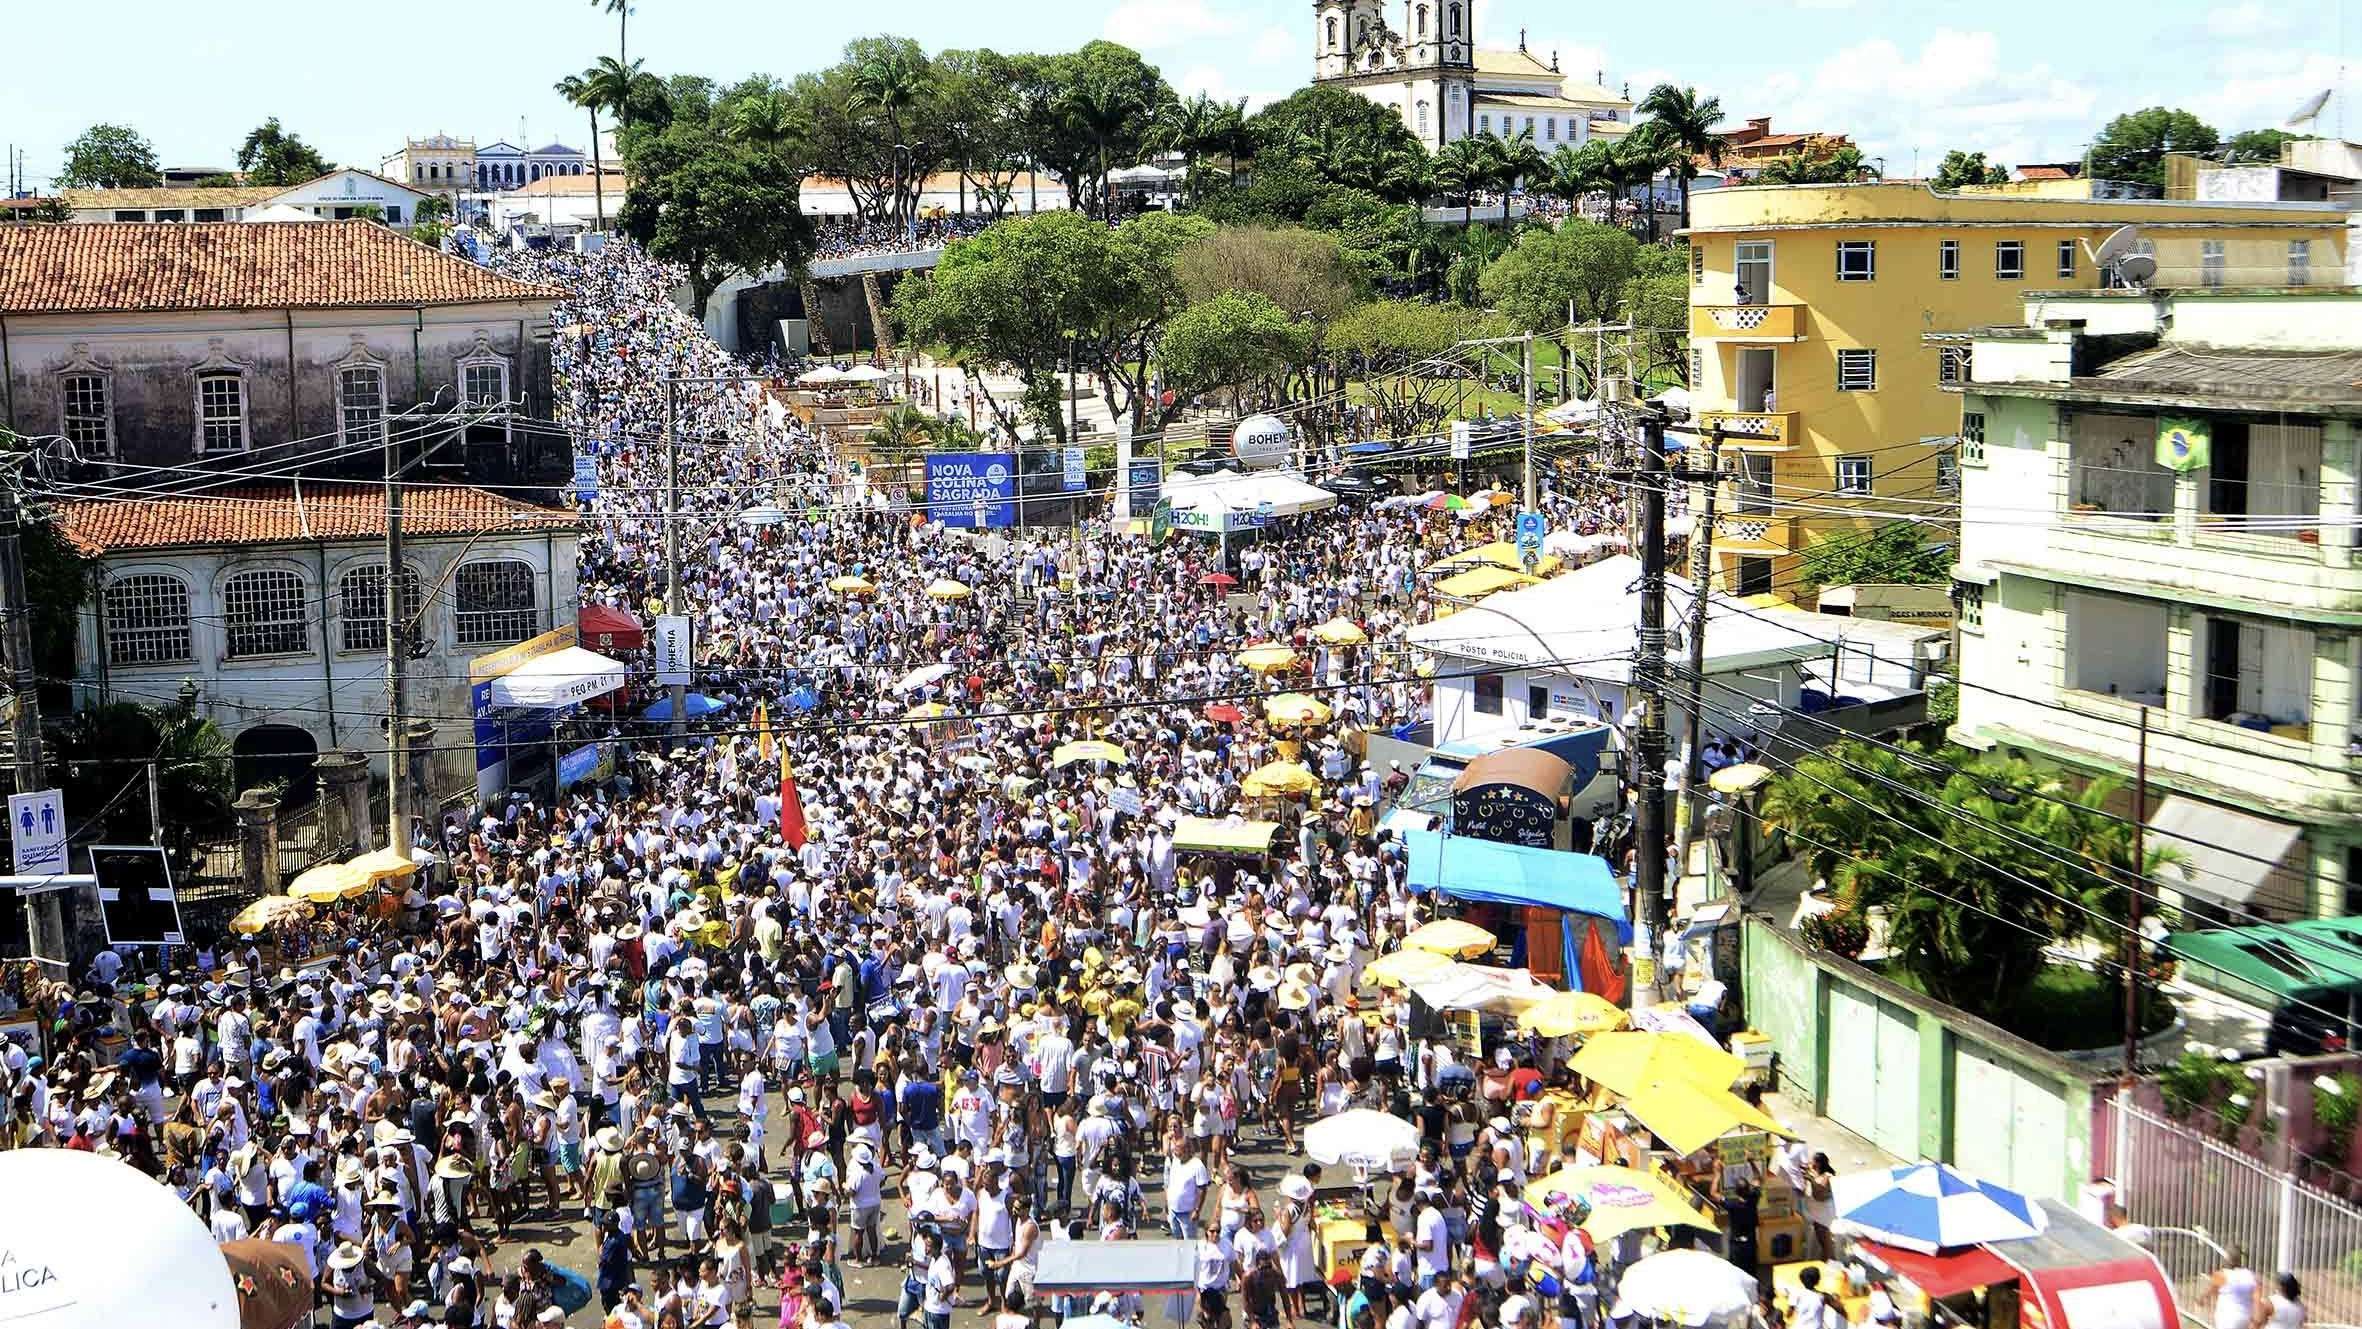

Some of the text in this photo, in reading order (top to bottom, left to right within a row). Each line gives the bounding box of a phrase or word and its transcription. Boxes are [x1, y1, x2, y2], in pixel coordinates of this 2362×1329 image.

[932, 464, 973, 476] NOVA
[932, 476, 987, 488] COLINA
[932, 488, 1001, 500] SAGRADA
[668, 629, 677, 673] BOHEMIA
[1460, 644, 1528, 662] POSTO POLICIAL
